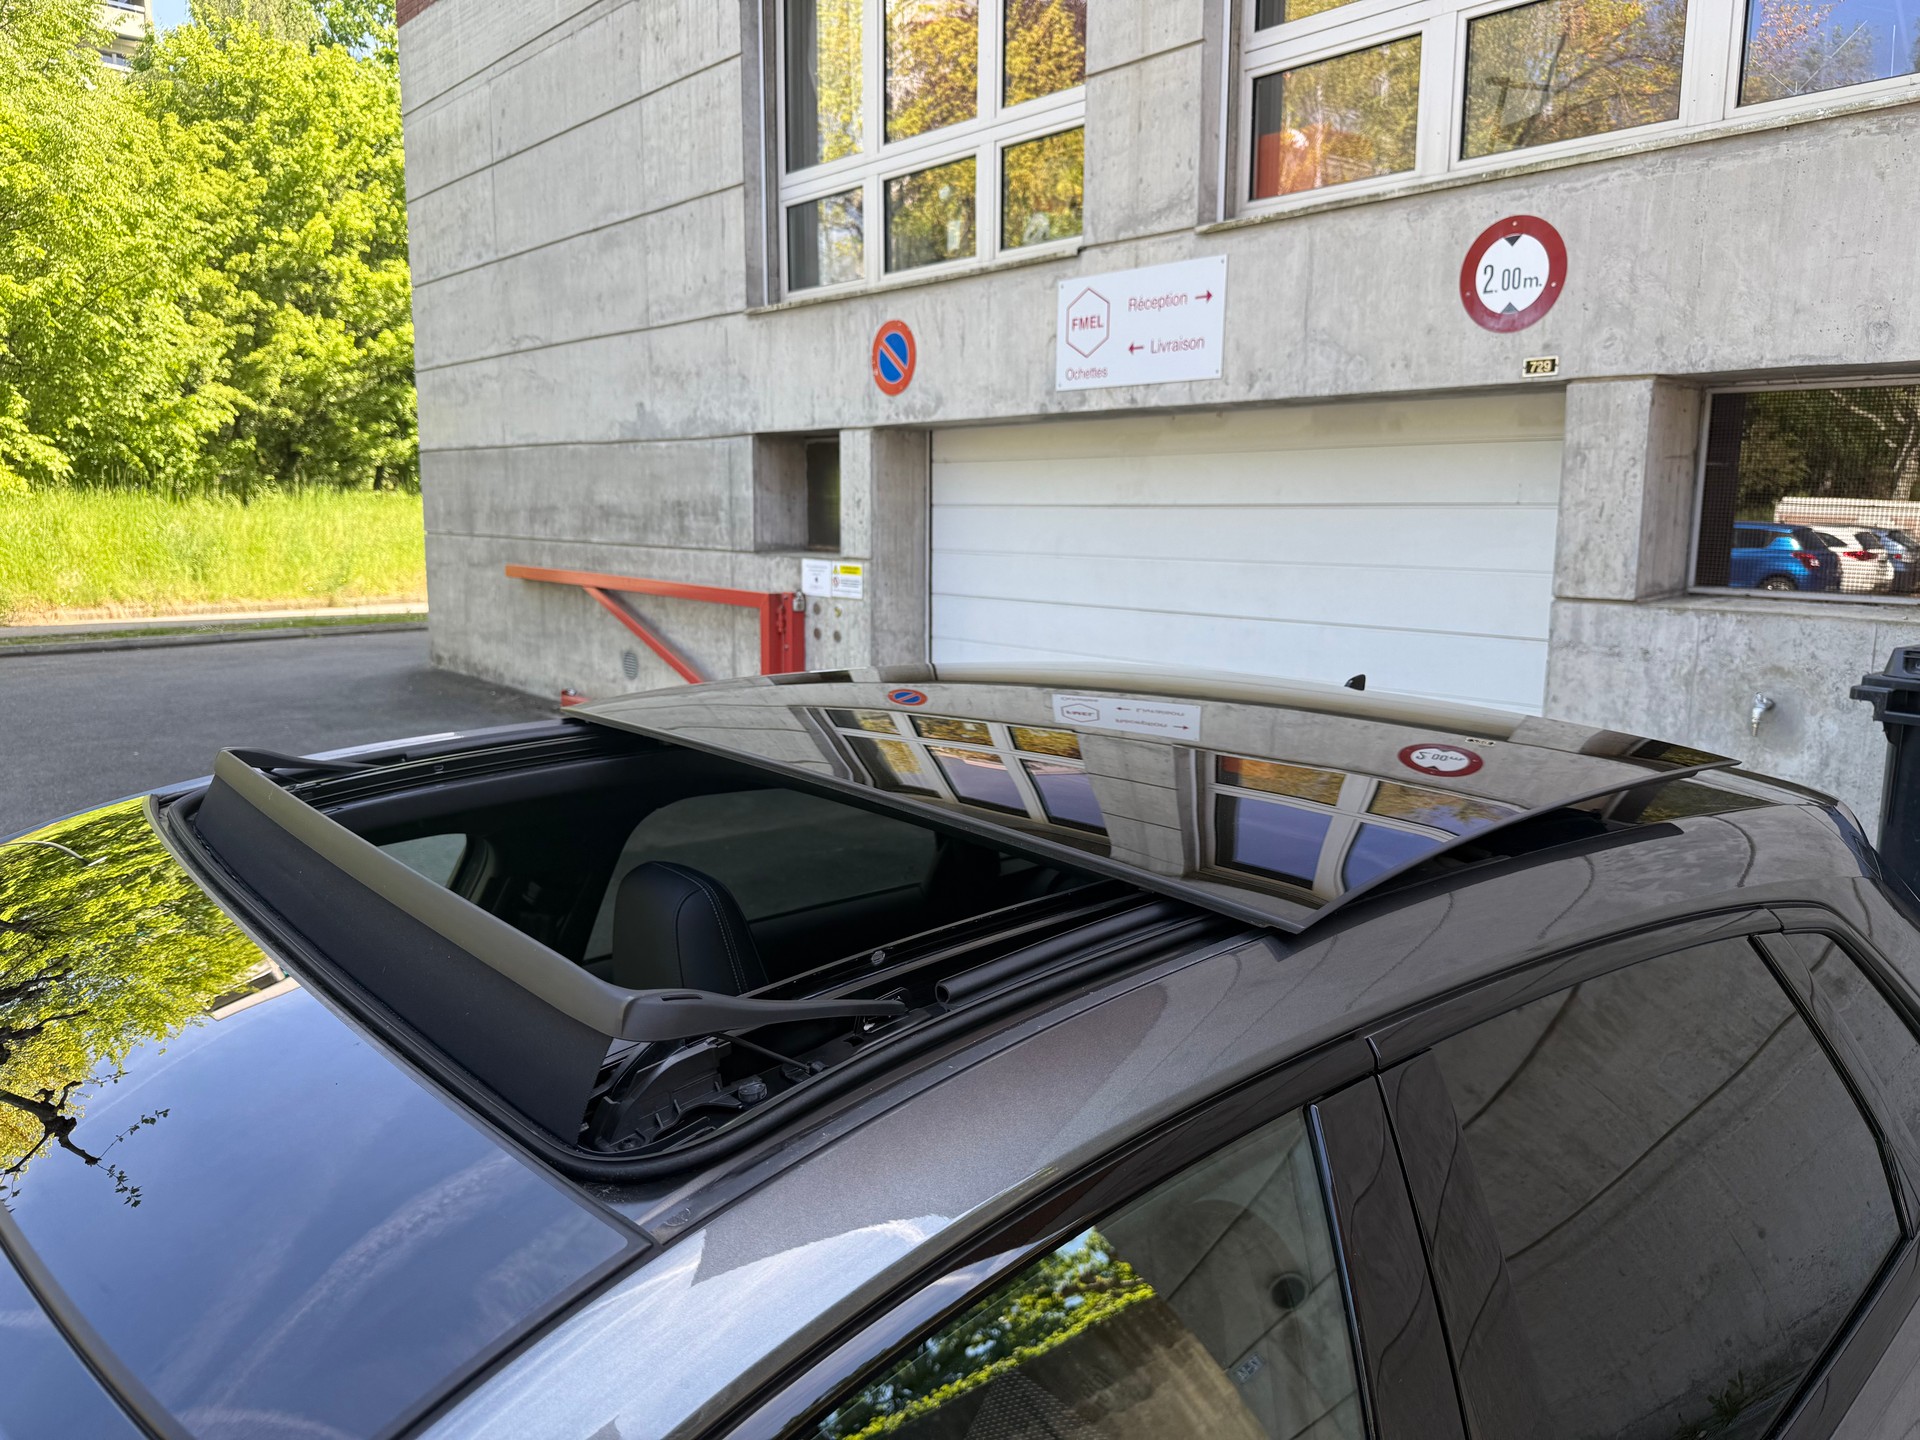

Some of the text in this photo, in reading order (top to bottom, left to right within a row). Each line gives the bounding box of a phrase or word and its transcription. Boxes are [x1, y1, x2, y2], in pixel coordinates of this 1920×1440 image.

[1128, 293, 1188, 312] Réception
[1071, 316, 1104, 331] FMEL
[1150, 335, 1205, 354] Livraison
[1530, 361, 1552, 373] 729
